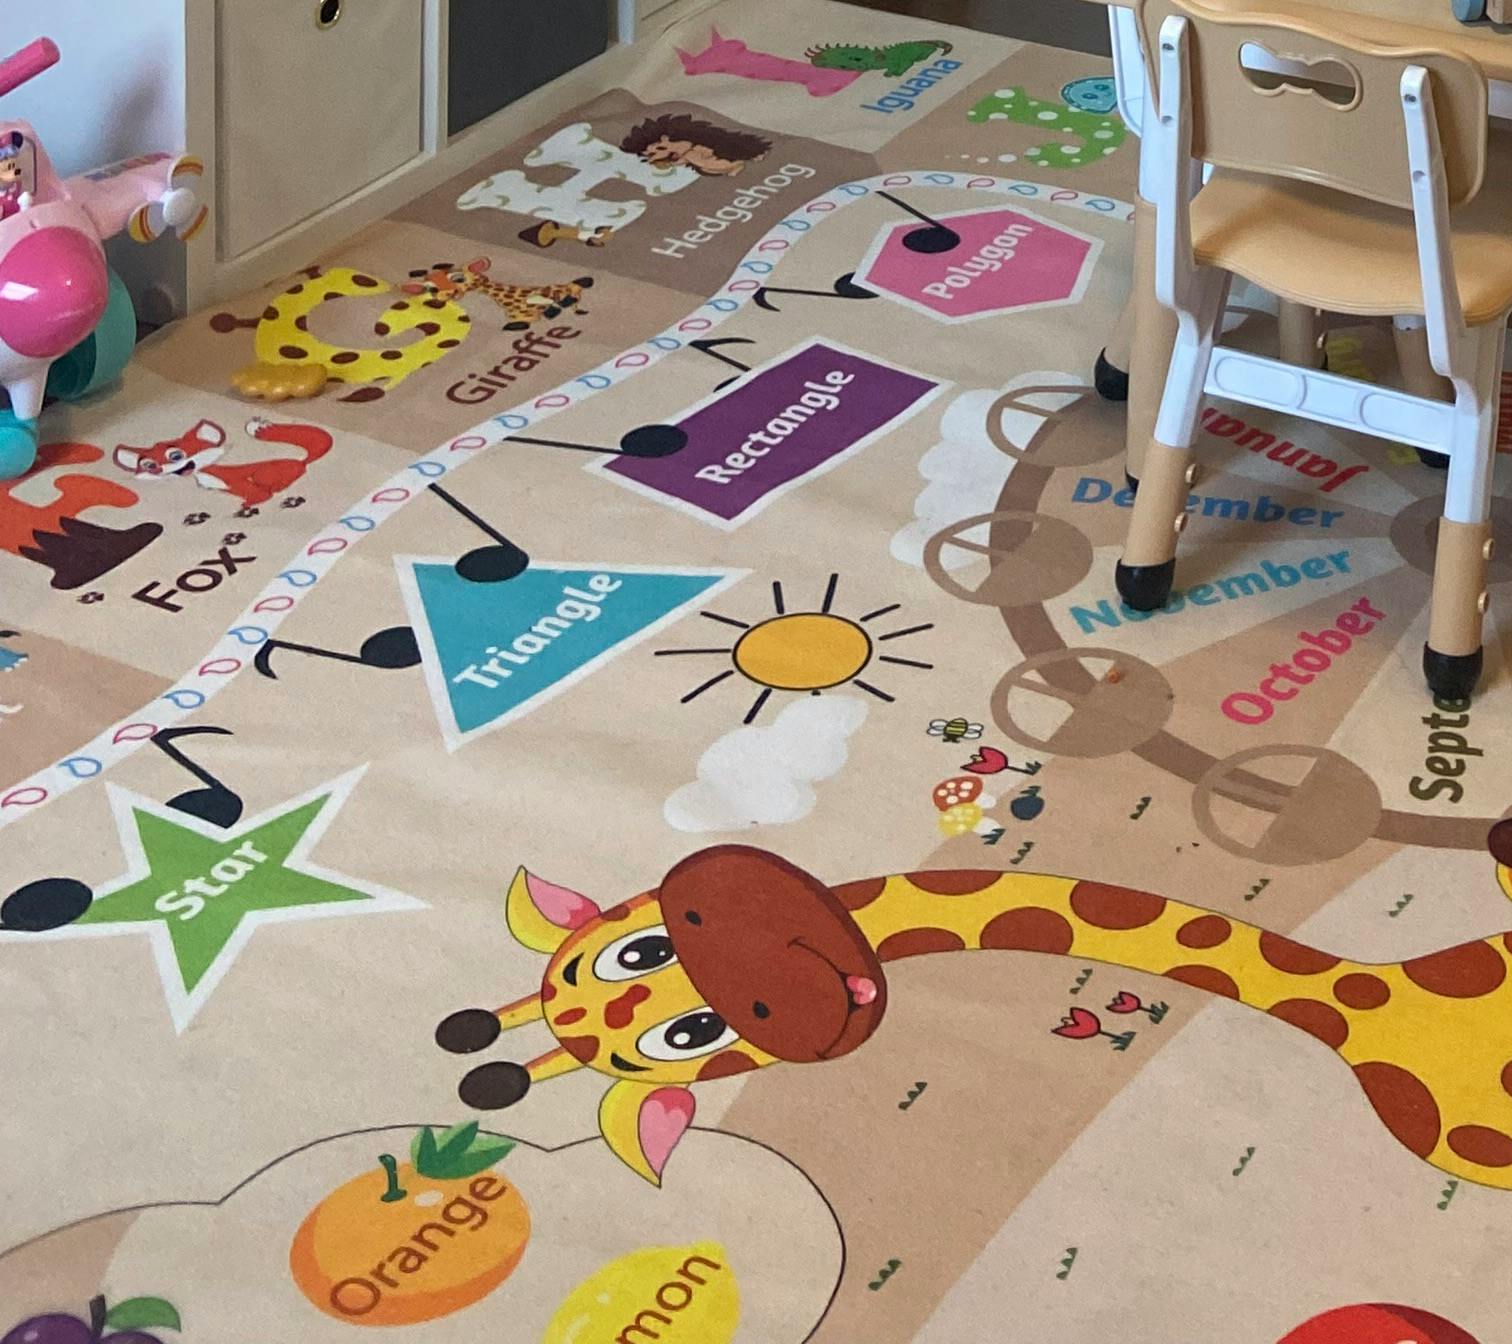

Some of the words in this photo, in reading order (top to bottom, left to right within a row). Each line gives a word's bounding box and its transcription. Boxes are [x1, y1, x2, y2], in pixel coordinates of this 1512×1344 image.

[860, 56, 963, 114] Iguana
[650, 161, 816, 260] Hedgehog
[921, 222, 1033, 300] Polygon
[446, 317, 581, 408] Giraffe
[695, 367, 855, 485] Rectangle
[1200, 407, 1369, 494] Janua
[1070, 476, 1345, 529] Deember
[133, 545, 257, 613] Fox
[1069, 548, 1351, 635] Nember
[453, 572, 622, 690] Triangle
[1221, 595, 1387, 726] October
[1410, 698, 1471, 804] Septe
[156, 836, 271, 922] Star
[329, 1172, 508, 1320] Orange
[615, 1249, 724, 1344] mon
